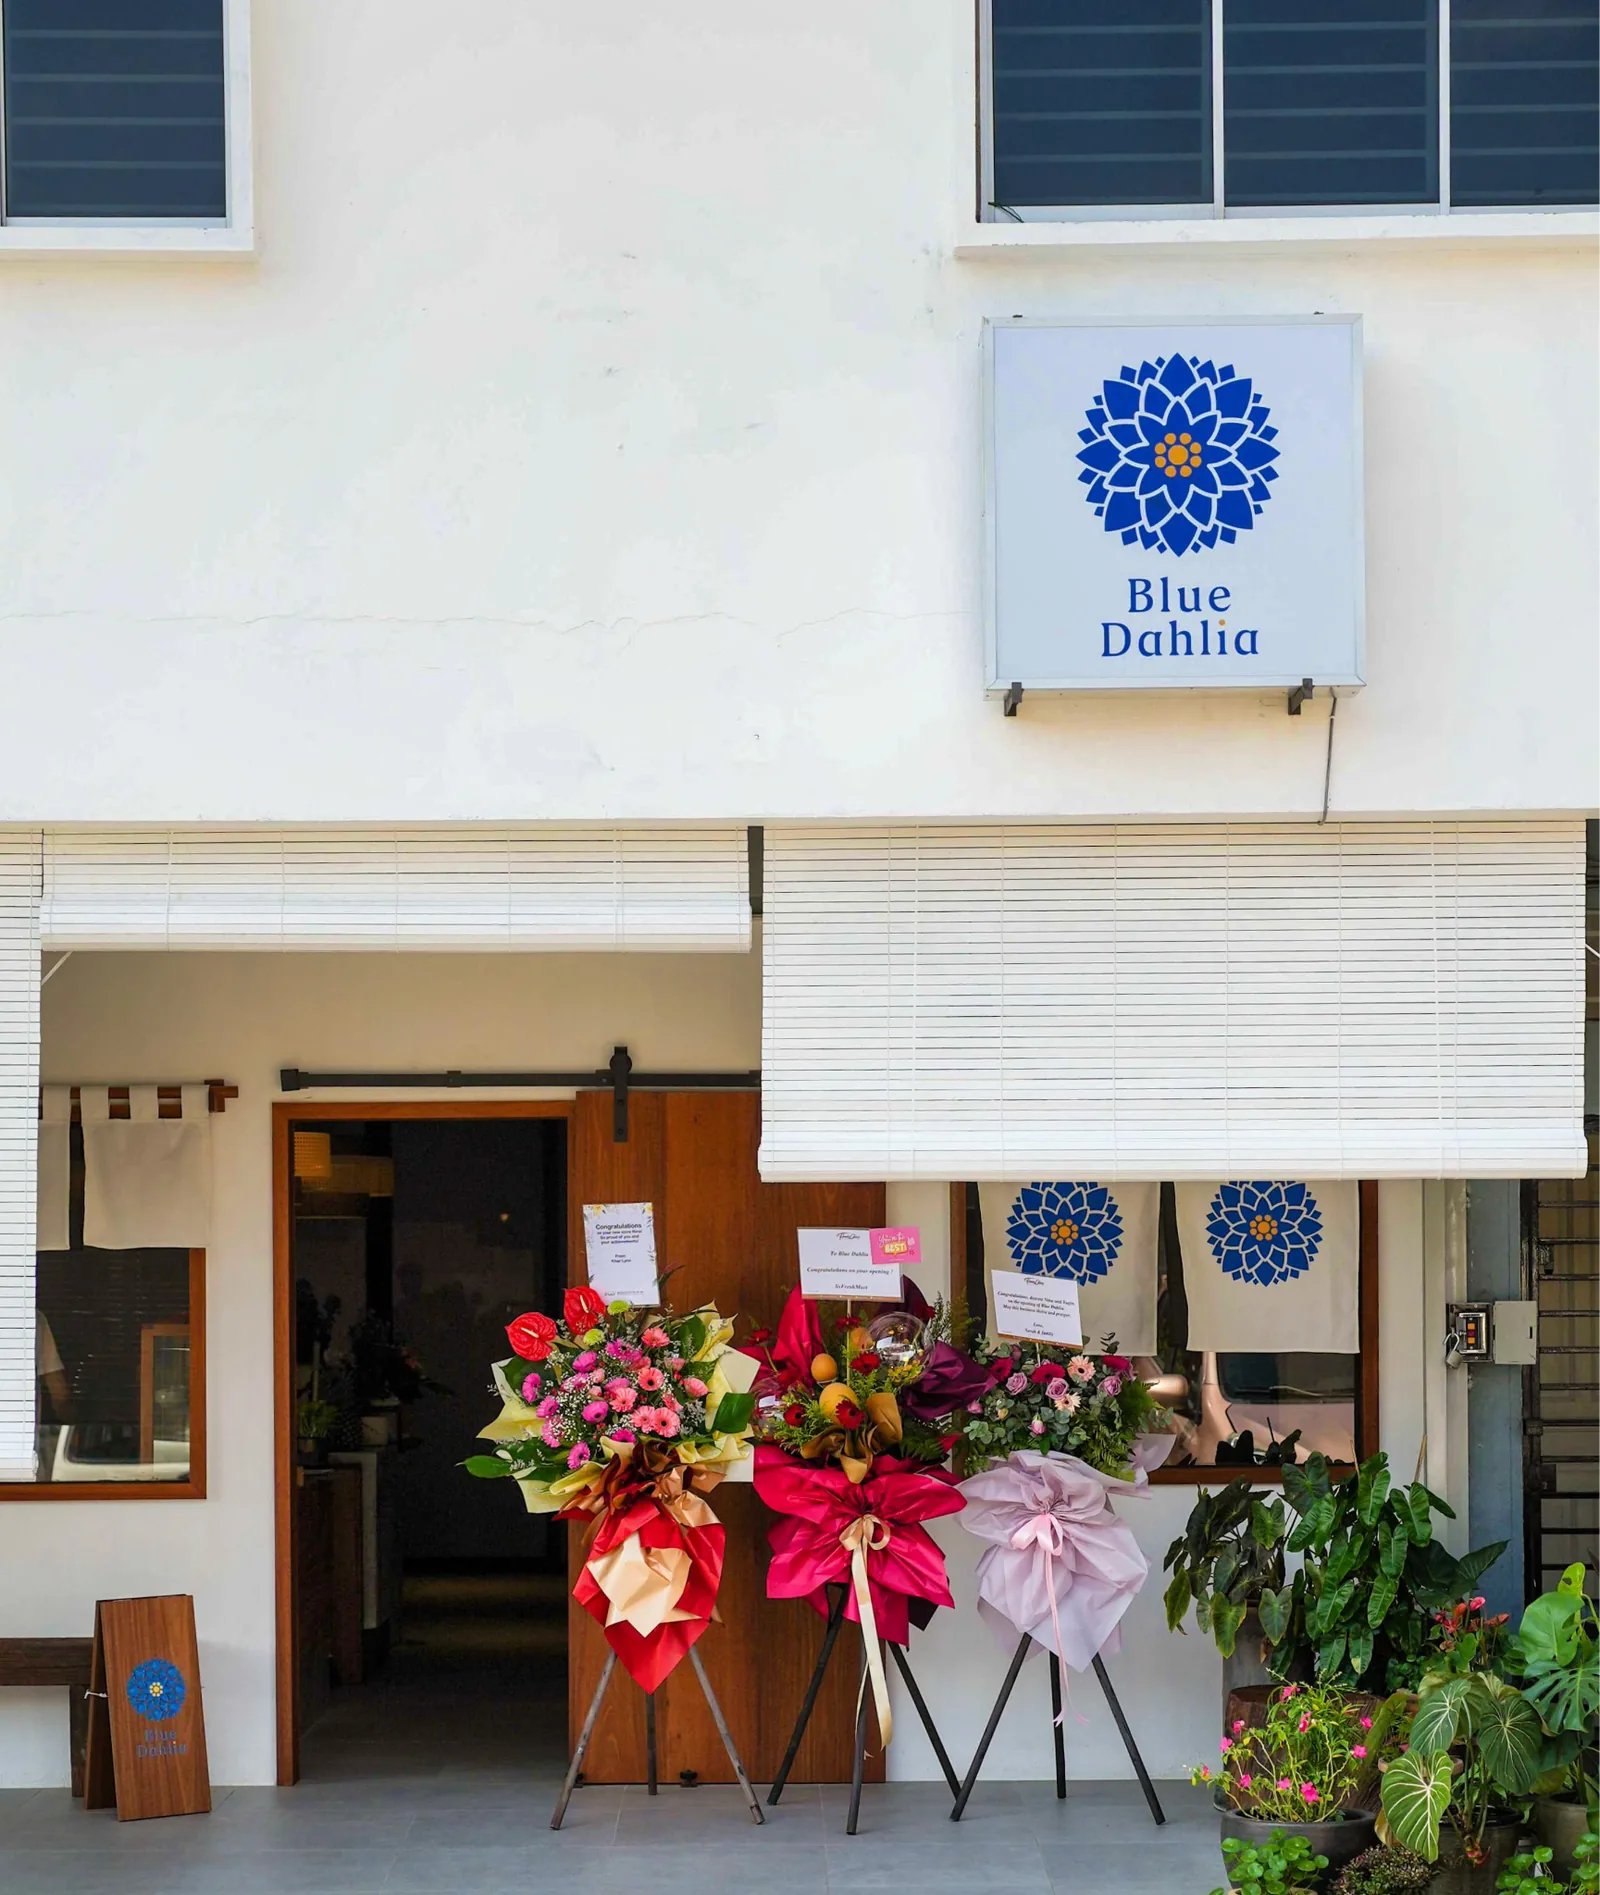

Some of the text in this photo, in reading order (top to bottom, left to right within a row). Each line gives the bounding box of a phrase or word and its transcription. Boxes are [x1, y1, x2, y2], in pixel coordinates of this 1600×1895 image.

[1128, 576, 1231, 613] Blue
[1101, 619, 1259, 657] Dahlia
[144, 1729, 176, 1742] Blue
[137, 1741, 188, 1758] Dahlia
